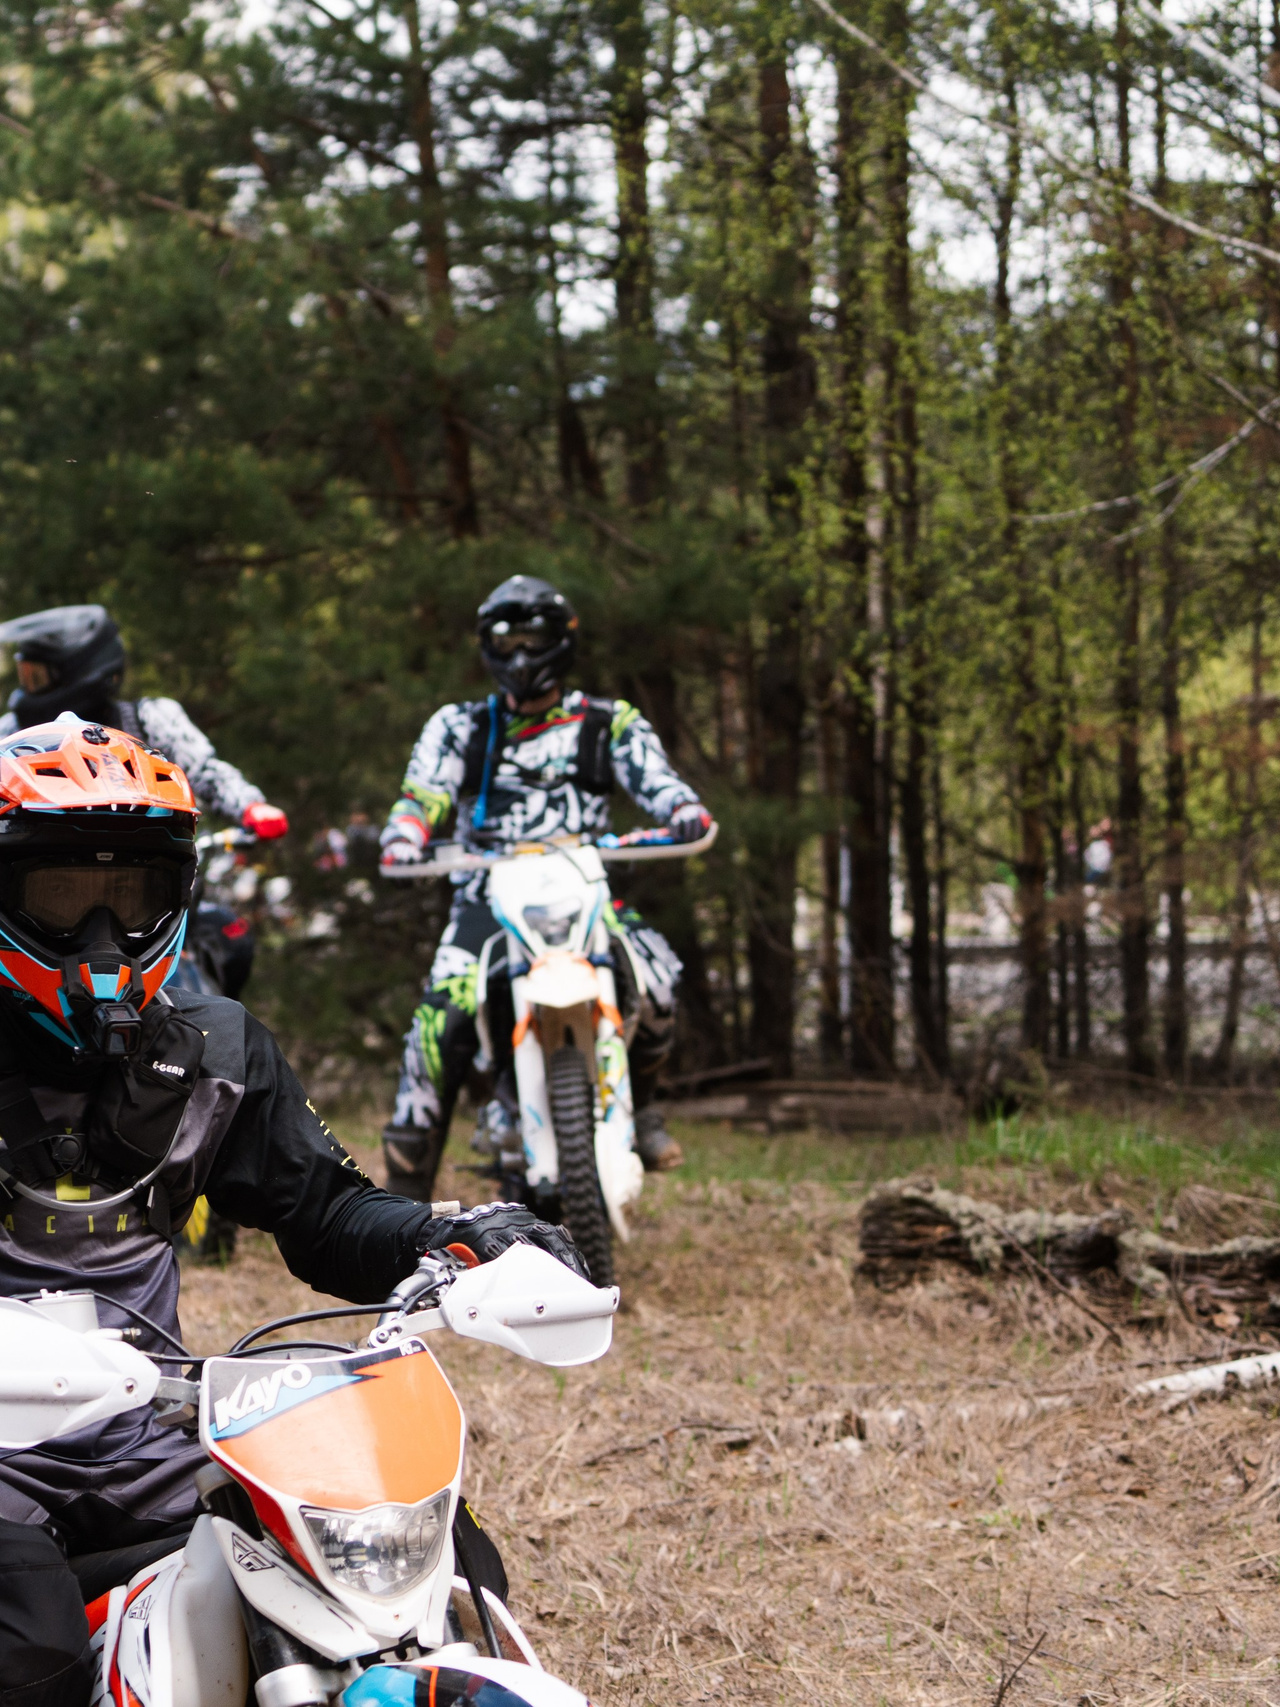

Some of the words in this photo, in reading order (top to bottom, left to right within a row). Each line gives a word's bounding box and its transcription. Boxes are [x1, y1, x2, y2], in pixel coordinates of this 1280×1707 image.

[152, 1060, 185, 1078] E-GEAR
[4, 1213, 148, 1234] ACIN
[214, 1363, 313, 1432] KAYO
